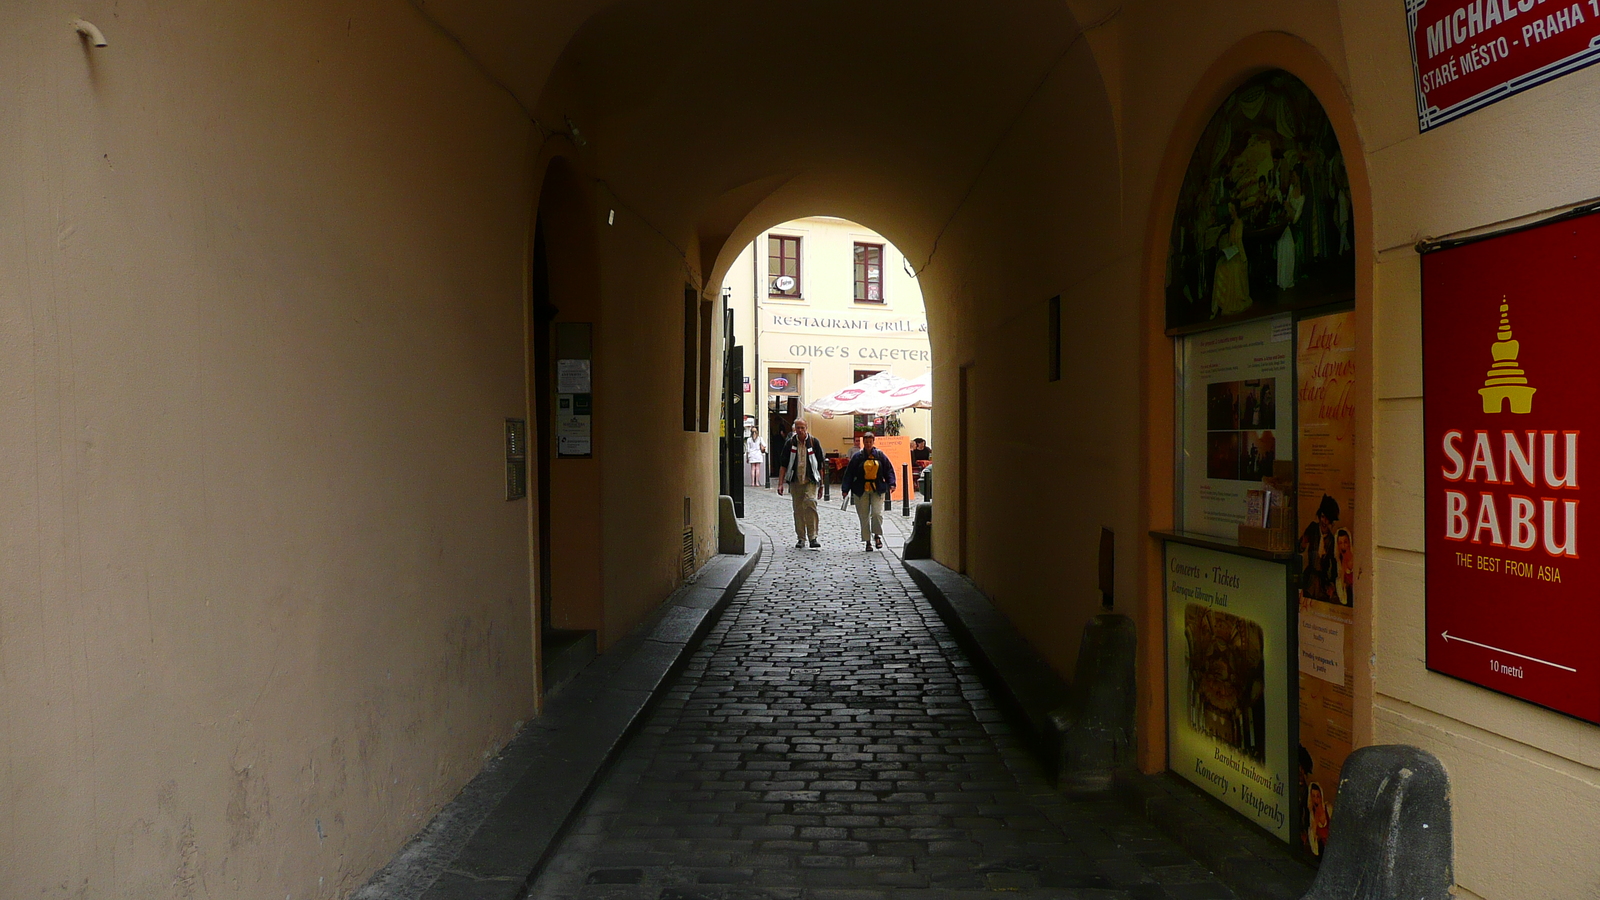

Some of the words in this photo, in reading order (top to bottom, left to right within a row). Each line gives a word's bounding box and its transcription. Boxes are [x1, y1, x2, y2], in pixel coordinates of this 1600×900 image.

[1426, 0, 1546, 59] MICHAL
[1422, 55, 1459, 93] STARÉ
[1459, 36, 1509, 77] MĚSTO
[1521, 3, 1585, 47] PRAHA
[773, 314, 871, 331] RESTAURANT
[875, 320, 914, 332] GRILL
[918, 323, 927, 332] &
[789, 344, 850, 358] MIKE'S
[769, 378, 789, 387] OPEN
[1442, 429, 1580, 490] SANU
[1443, 489, 1580, 560] BABU
[1170, 557, 1201, 579] Concerts
[1212, 565, 1241, 590] Tickets
[1455, 552, 1473, 570] THE
[1477, 554, 1501, 573] BEST
[1505, 558, 1534, 579] FROM
[1537, 563, 1561, 583] ASIA
[1171, 581, 1194, 601] Baroque
[1194, 585, 1215, 608] library
[1214, 592, 1227, 608] hall
[1490, 658, 1499, 673] 10
[1500, 662, 1524, 679] metrů
[1214, 746, 1241, 773] Barokní
[1241, 759, 1272, 789] knihovní
[1273, 779, 1284, 797] sál
[1195, 757, 1229, 795] Koncerty
[1240, 783, 1285, 829] Vstupenky
